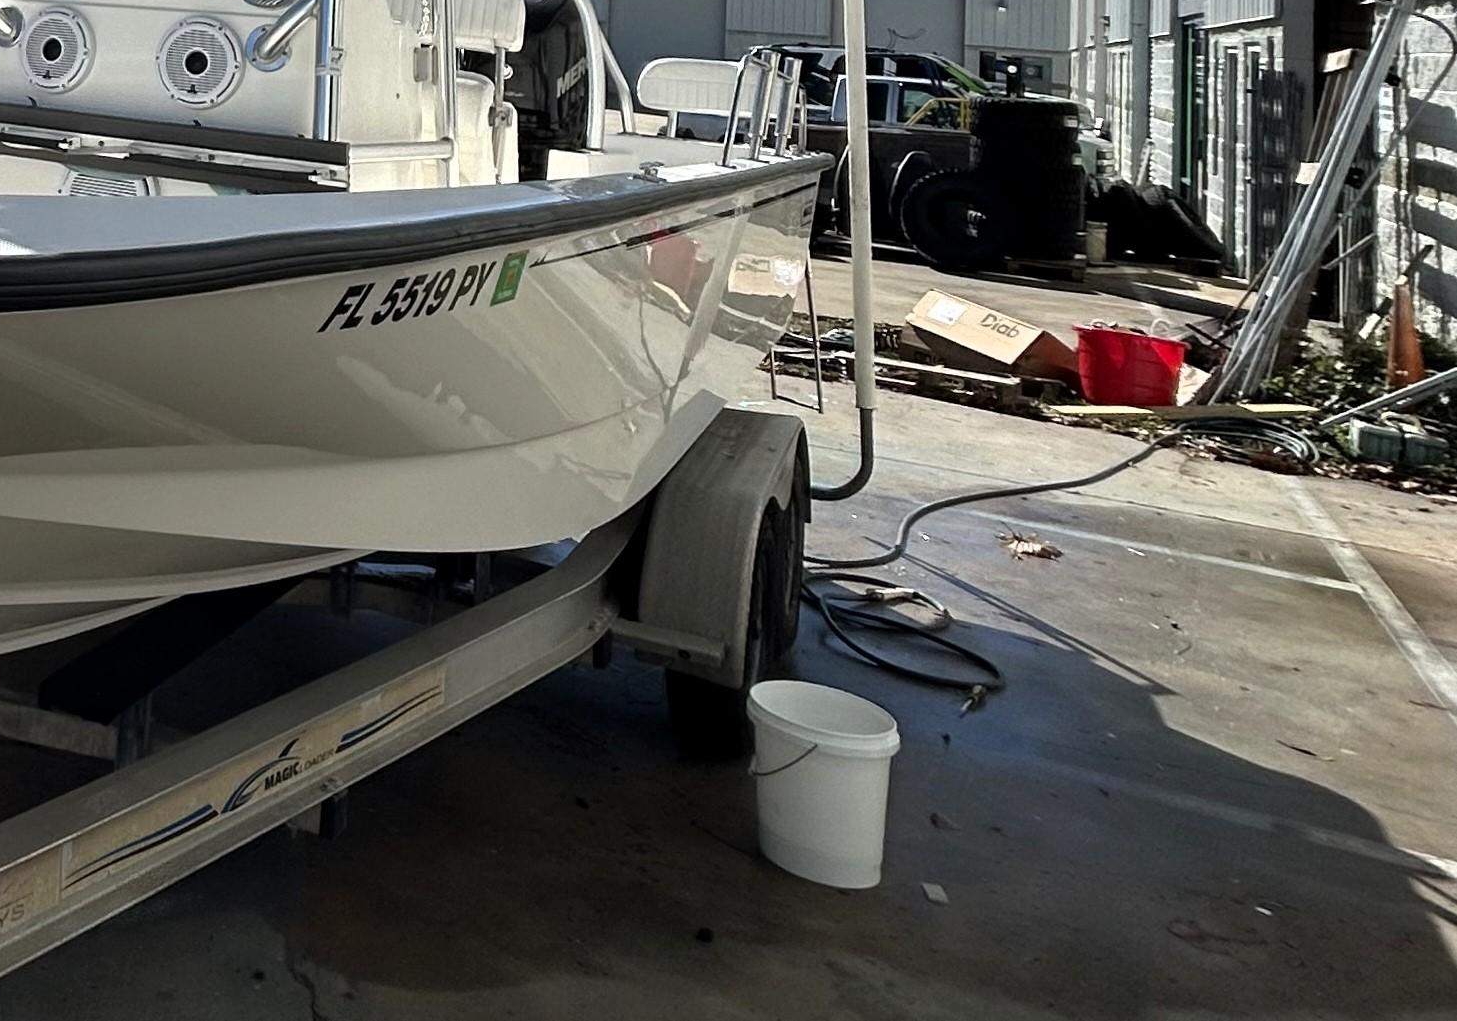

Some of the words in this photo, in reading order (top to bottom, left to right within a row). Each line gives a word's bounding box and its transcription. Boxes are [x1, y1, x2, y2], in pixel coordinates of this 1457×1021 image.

[556, 56, 587, 98] MER
[316, 282, 376, 333] FL
[370, 268, 456, 325] 5519
[447, 261, 497, 311] PY
[980, 313, 1020, 338] Diab
[264, 761, 300, 790] MAGIC
